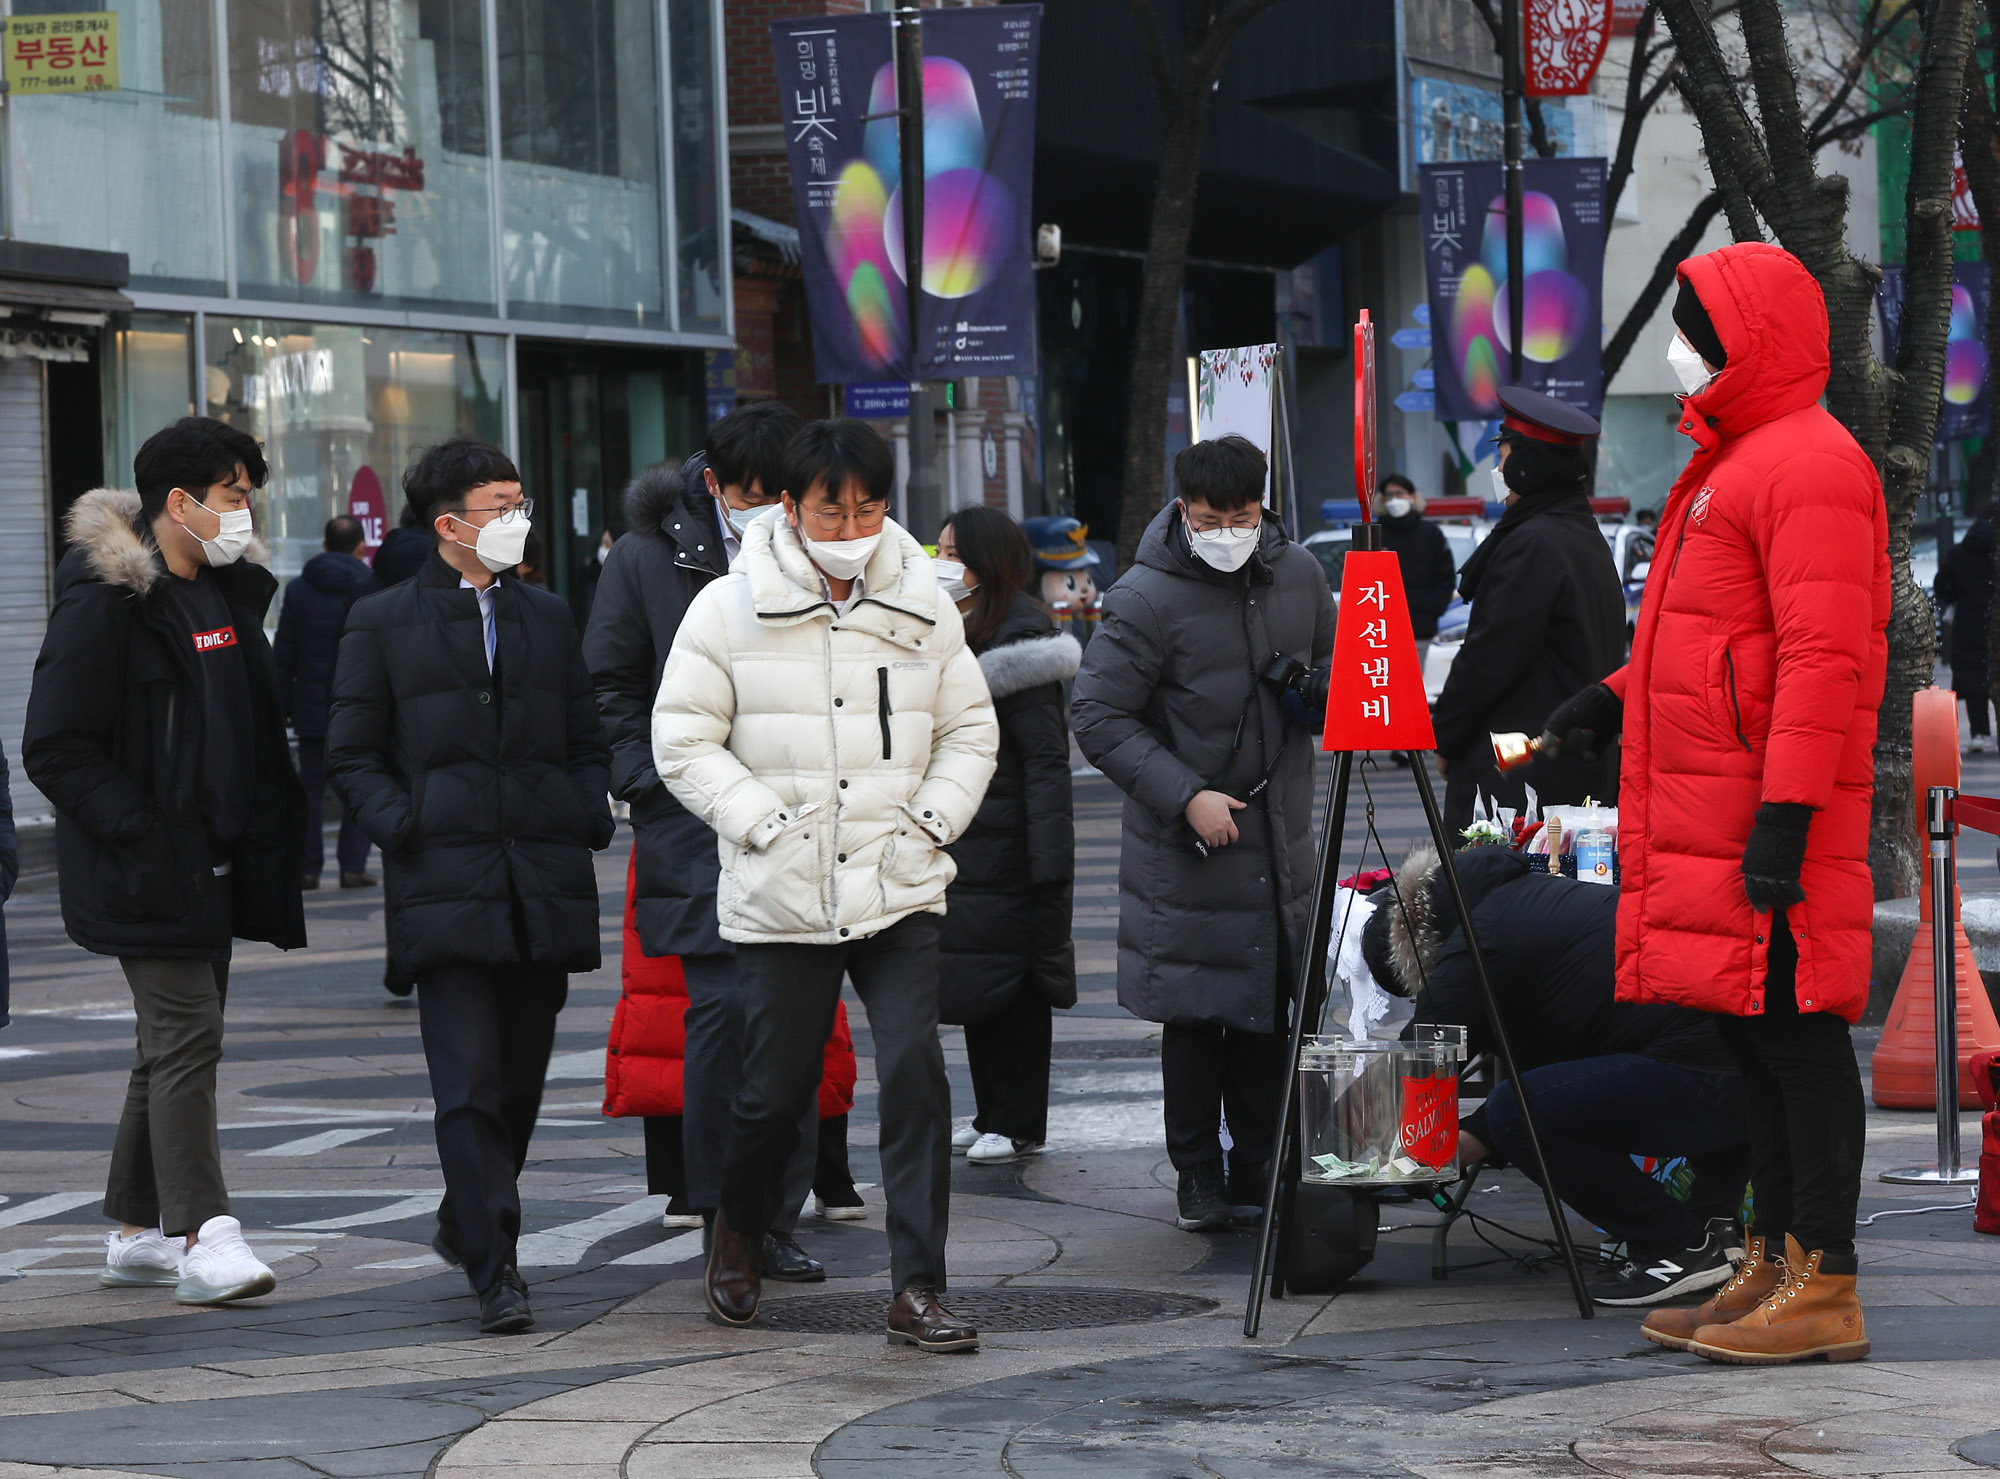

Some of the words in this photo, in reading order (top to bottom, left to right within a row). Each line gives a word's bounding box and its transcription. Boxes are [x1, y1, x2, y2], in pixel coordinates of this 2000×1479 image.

[51, 20, 109, 34] 공인중개사
[14, 35, 108, 70] 부동산
[797, 40, 816, 80] 희망
[793, 86, 838, 142] 빛
[808, 136, 826, 175] 축제
[1430, 211, 1462, 250] 빛
[1356, 580, 1391, 727] 자선냄비
